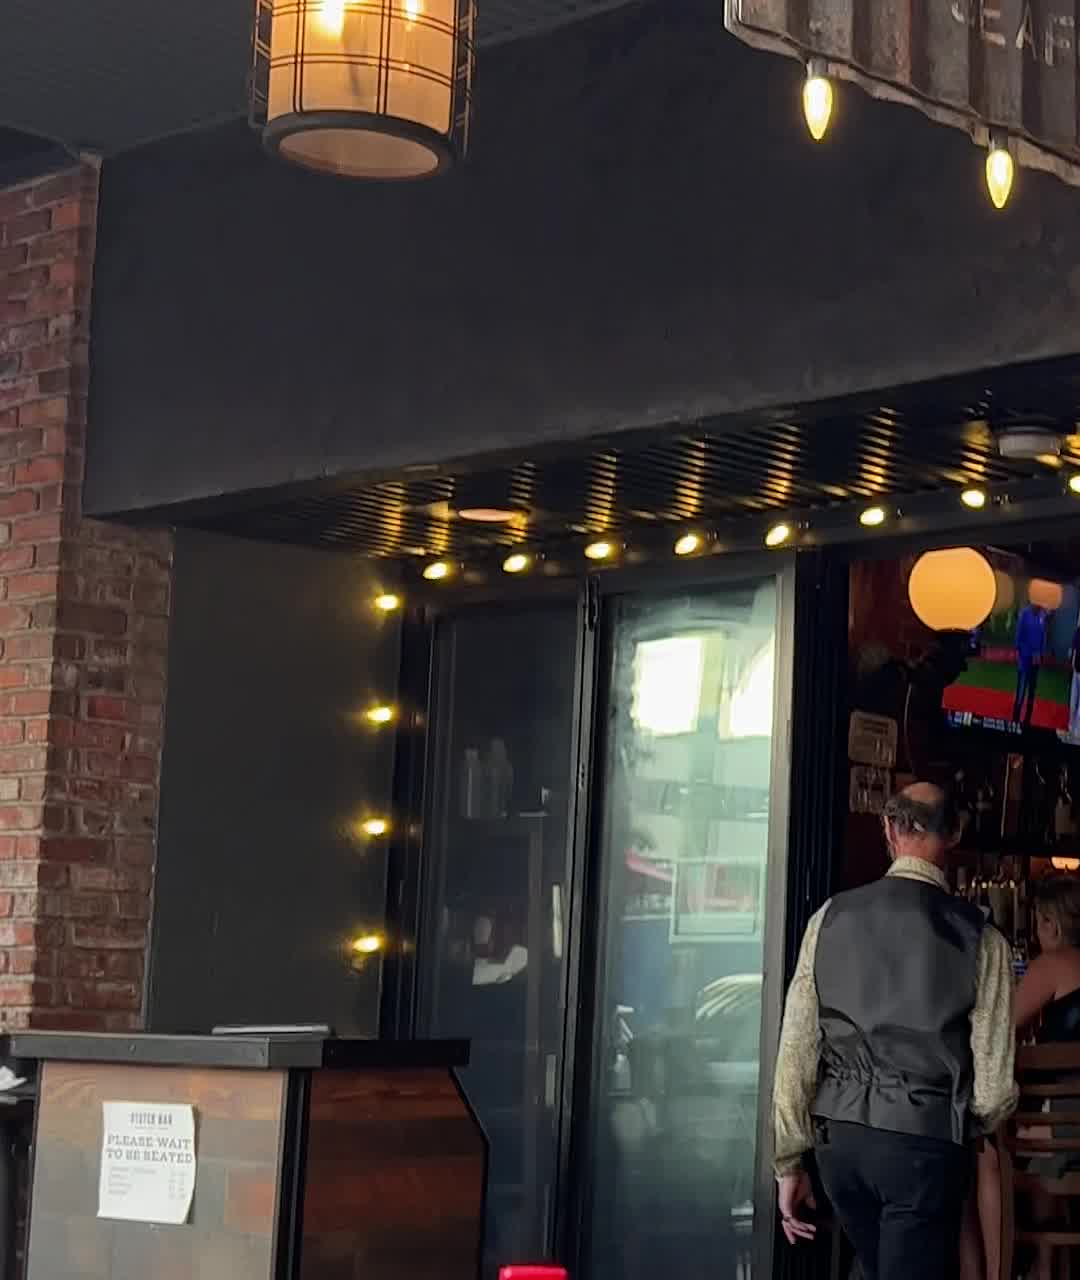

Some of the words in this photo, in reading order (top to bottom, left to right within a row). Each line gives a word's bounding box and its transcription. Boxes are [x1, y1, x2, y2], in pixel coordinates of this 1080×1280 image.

[107, 1134, 154, 1148] PLEASE
[156, 1137, 192, 1151] WAIT
[106, 1147, 123, 1160] TO
